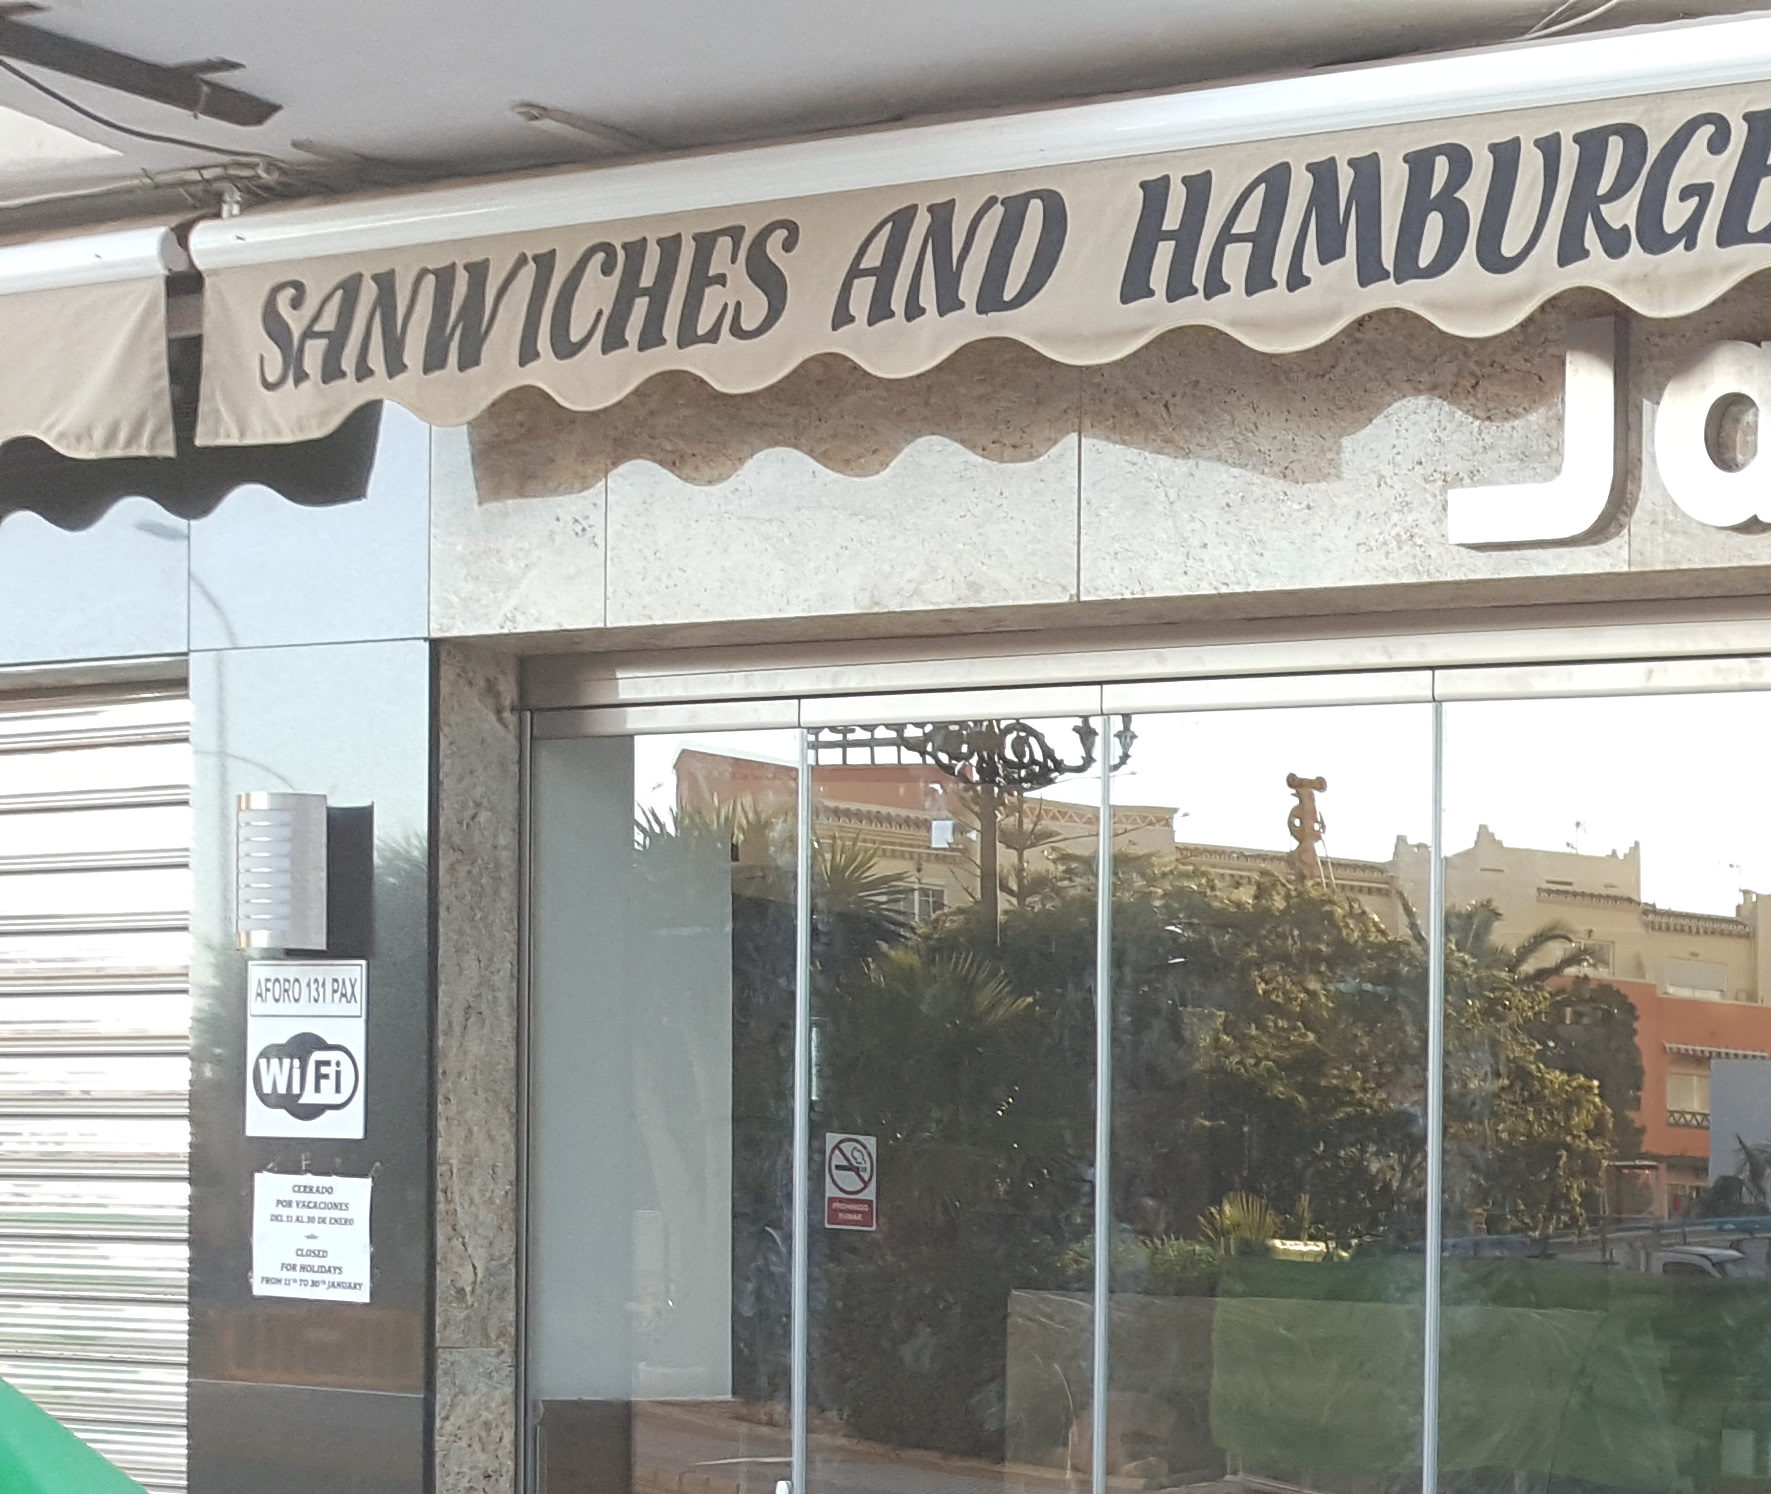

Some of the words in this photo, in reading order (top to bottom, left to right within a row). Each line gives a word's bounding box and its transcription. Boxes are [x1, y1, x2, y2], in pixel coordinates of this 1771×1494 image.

[259, 218, 800, 392] SANWICHES
[831, 188, 1068, 331] AND
[255, 977, 302, 1004] AFORO
[306, 977, 327, 1004] 131
[331, 977, 358, 1004] PAX
[292, 1184, 334, 1195] CERRADO
[275, 1198, 293, 1208] POR
[295, 1200, 350, 1211] VACACIONES
[295, 1248, 329, 1258] CLOSED
[280, 1262, 298, 1272] FOR
[298, 1263, 344, 1275] HOLIDAYS
